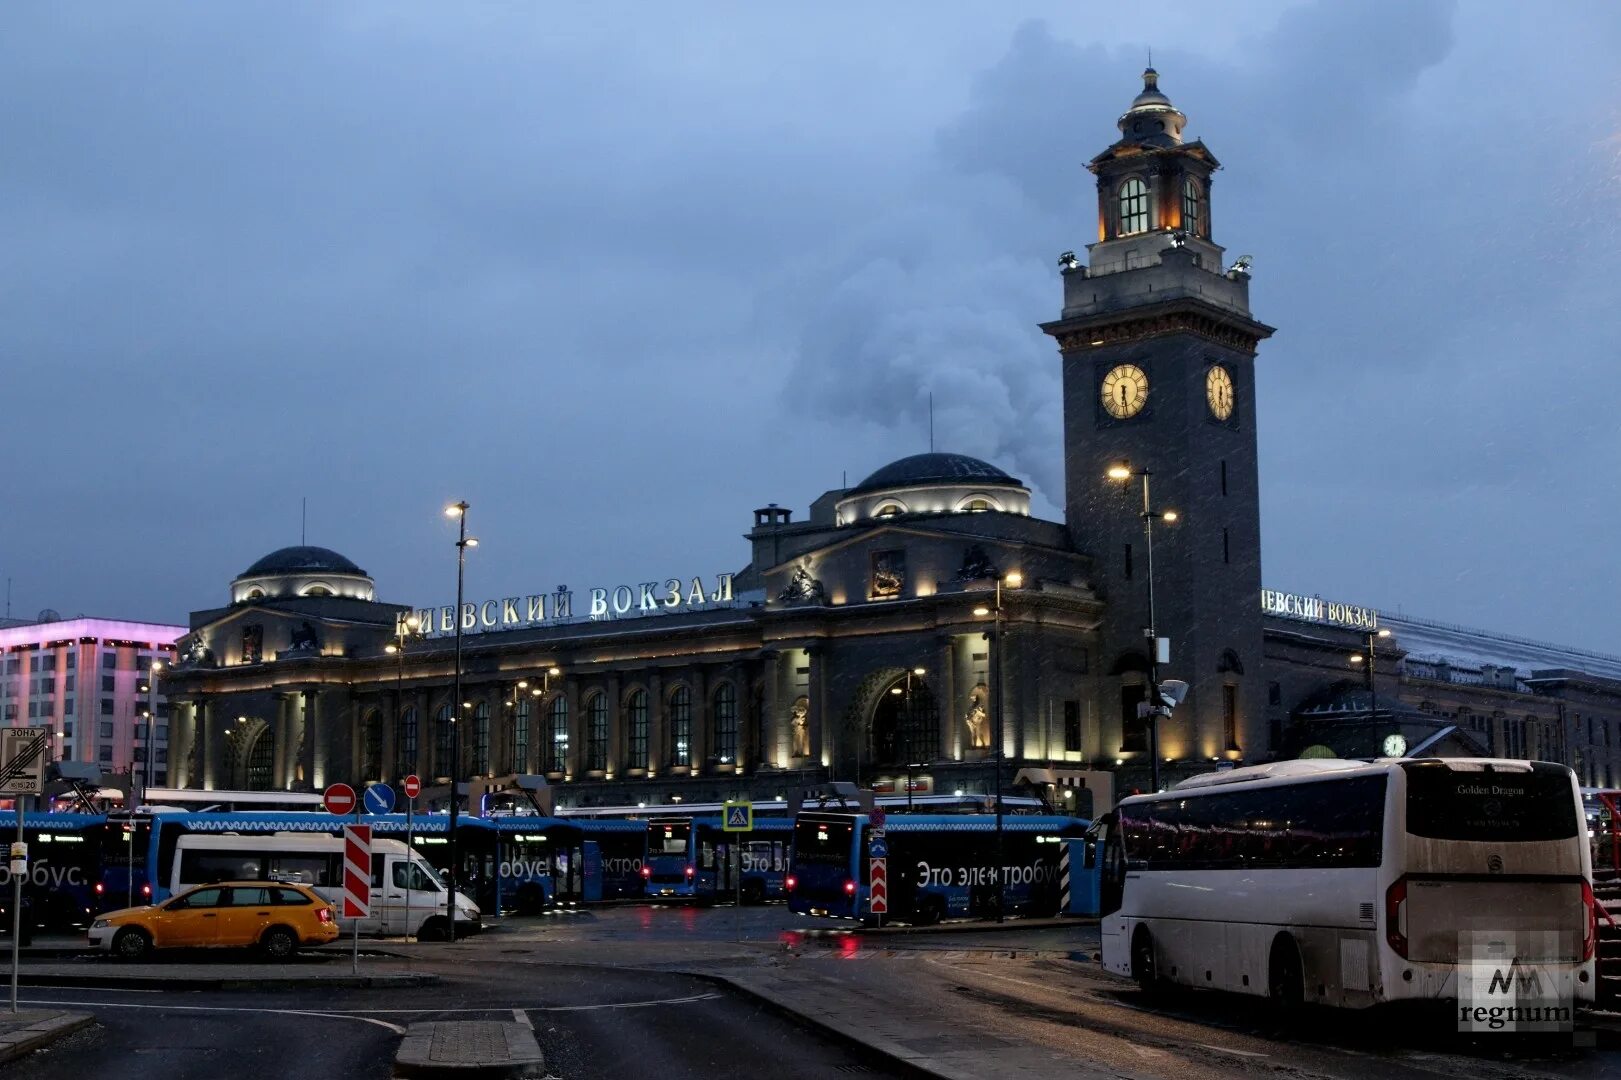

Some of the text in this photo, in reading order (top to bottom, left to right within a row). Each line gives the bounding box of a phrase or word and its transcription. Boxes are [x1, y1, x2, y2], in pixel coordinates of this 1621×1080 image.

[394, 572, 735, 636] КИЕВСКИЙ ВОКЗАЛ
[1327, 601, 1377, 628] ВОКЗАЛ
[11, 729, 36, 737] ЗОНА
[1457, 784, 1524, 797] Golden Dragon
[741, 852, 768, 872] Это
[916, 860, 952, 887] Это
